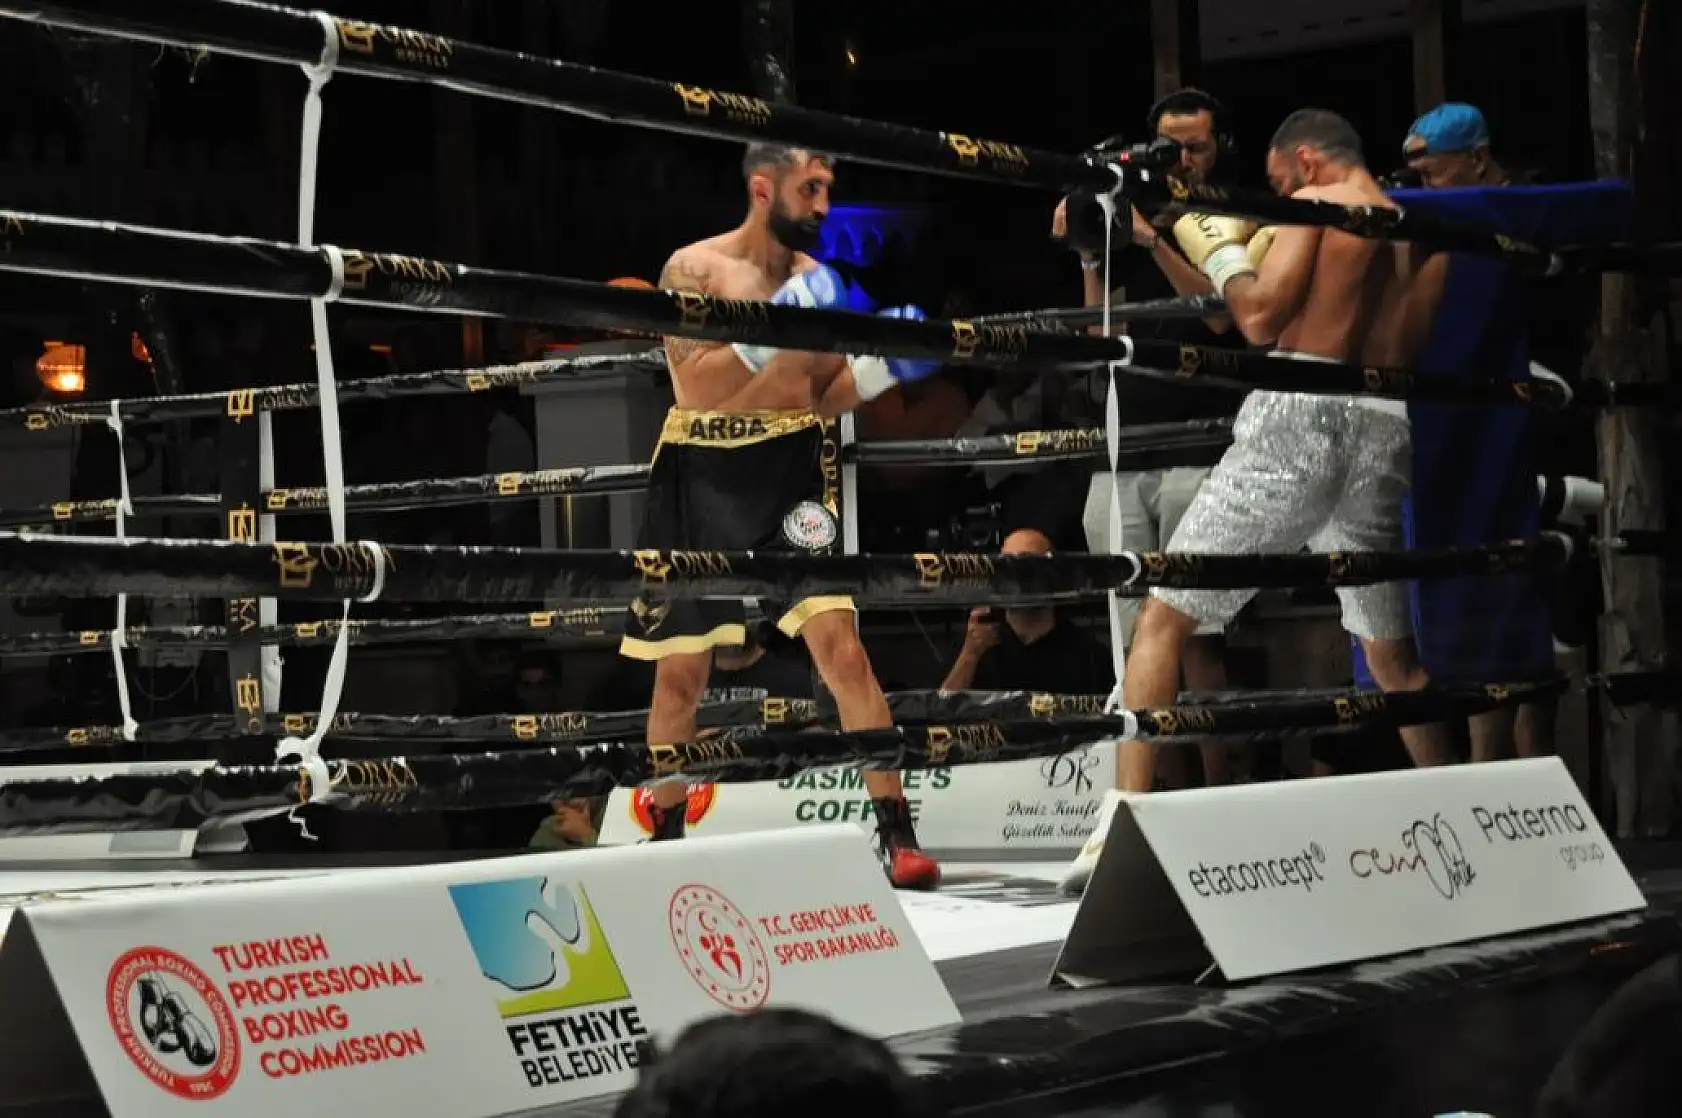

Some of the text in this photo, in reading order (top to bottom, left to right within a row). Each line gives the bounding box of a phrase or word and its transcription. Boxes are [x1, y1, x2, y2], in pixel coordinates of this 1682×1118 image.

[688, 418, 768, 439] ARDA
[778, 767, 951, 790] JASME'S
[795, 799, 922, 822] COFFE
[1471, 801, 1588, 844] Paterna
[212, 933, 330, 973] TURKISH
[774, 940, 818, 966] SPOR
[228, 957, 424, 1008] PROFESSIONAL
[243, 1004, 349, 1044] BOXING
[260, 1028, 427, 1079] COMMISSION
